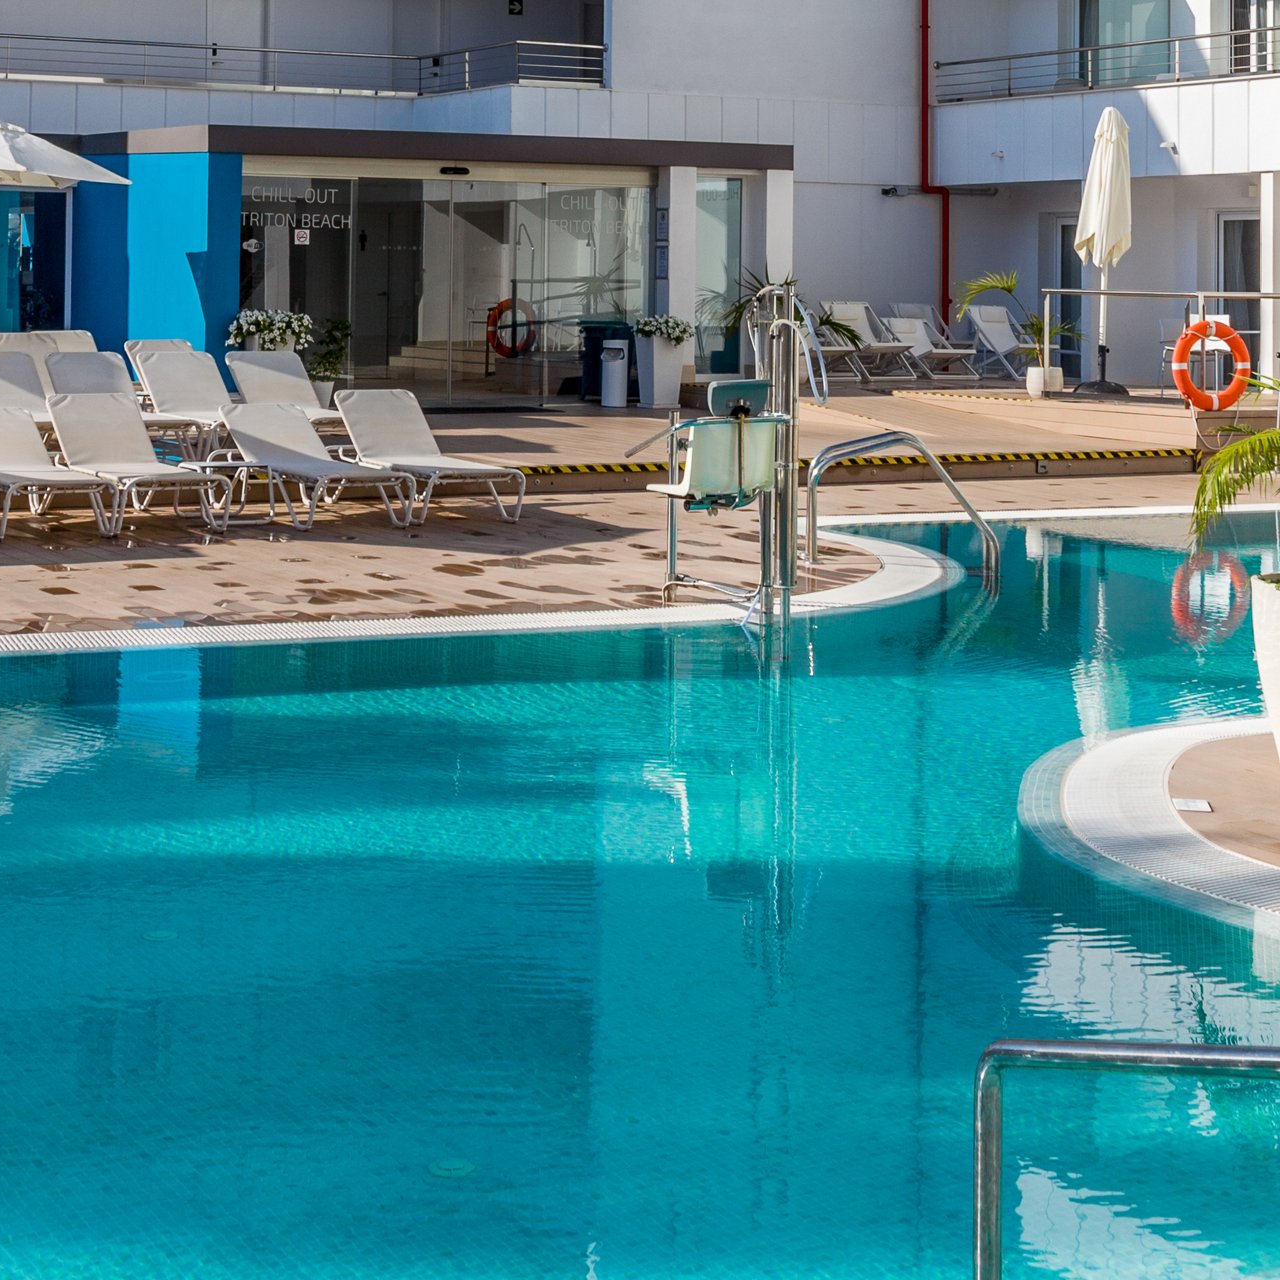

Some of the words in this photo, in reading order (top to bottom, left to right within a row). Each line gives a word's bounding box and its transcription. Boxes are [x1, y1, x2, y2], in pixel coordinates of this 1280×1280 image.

[251, 186, 339, 204] CHILL-OUT
[241, 212, 296, 228] TRITON
[301, 214, 352, 229] BEACH
[606, 220, 649, 236] BEAC
